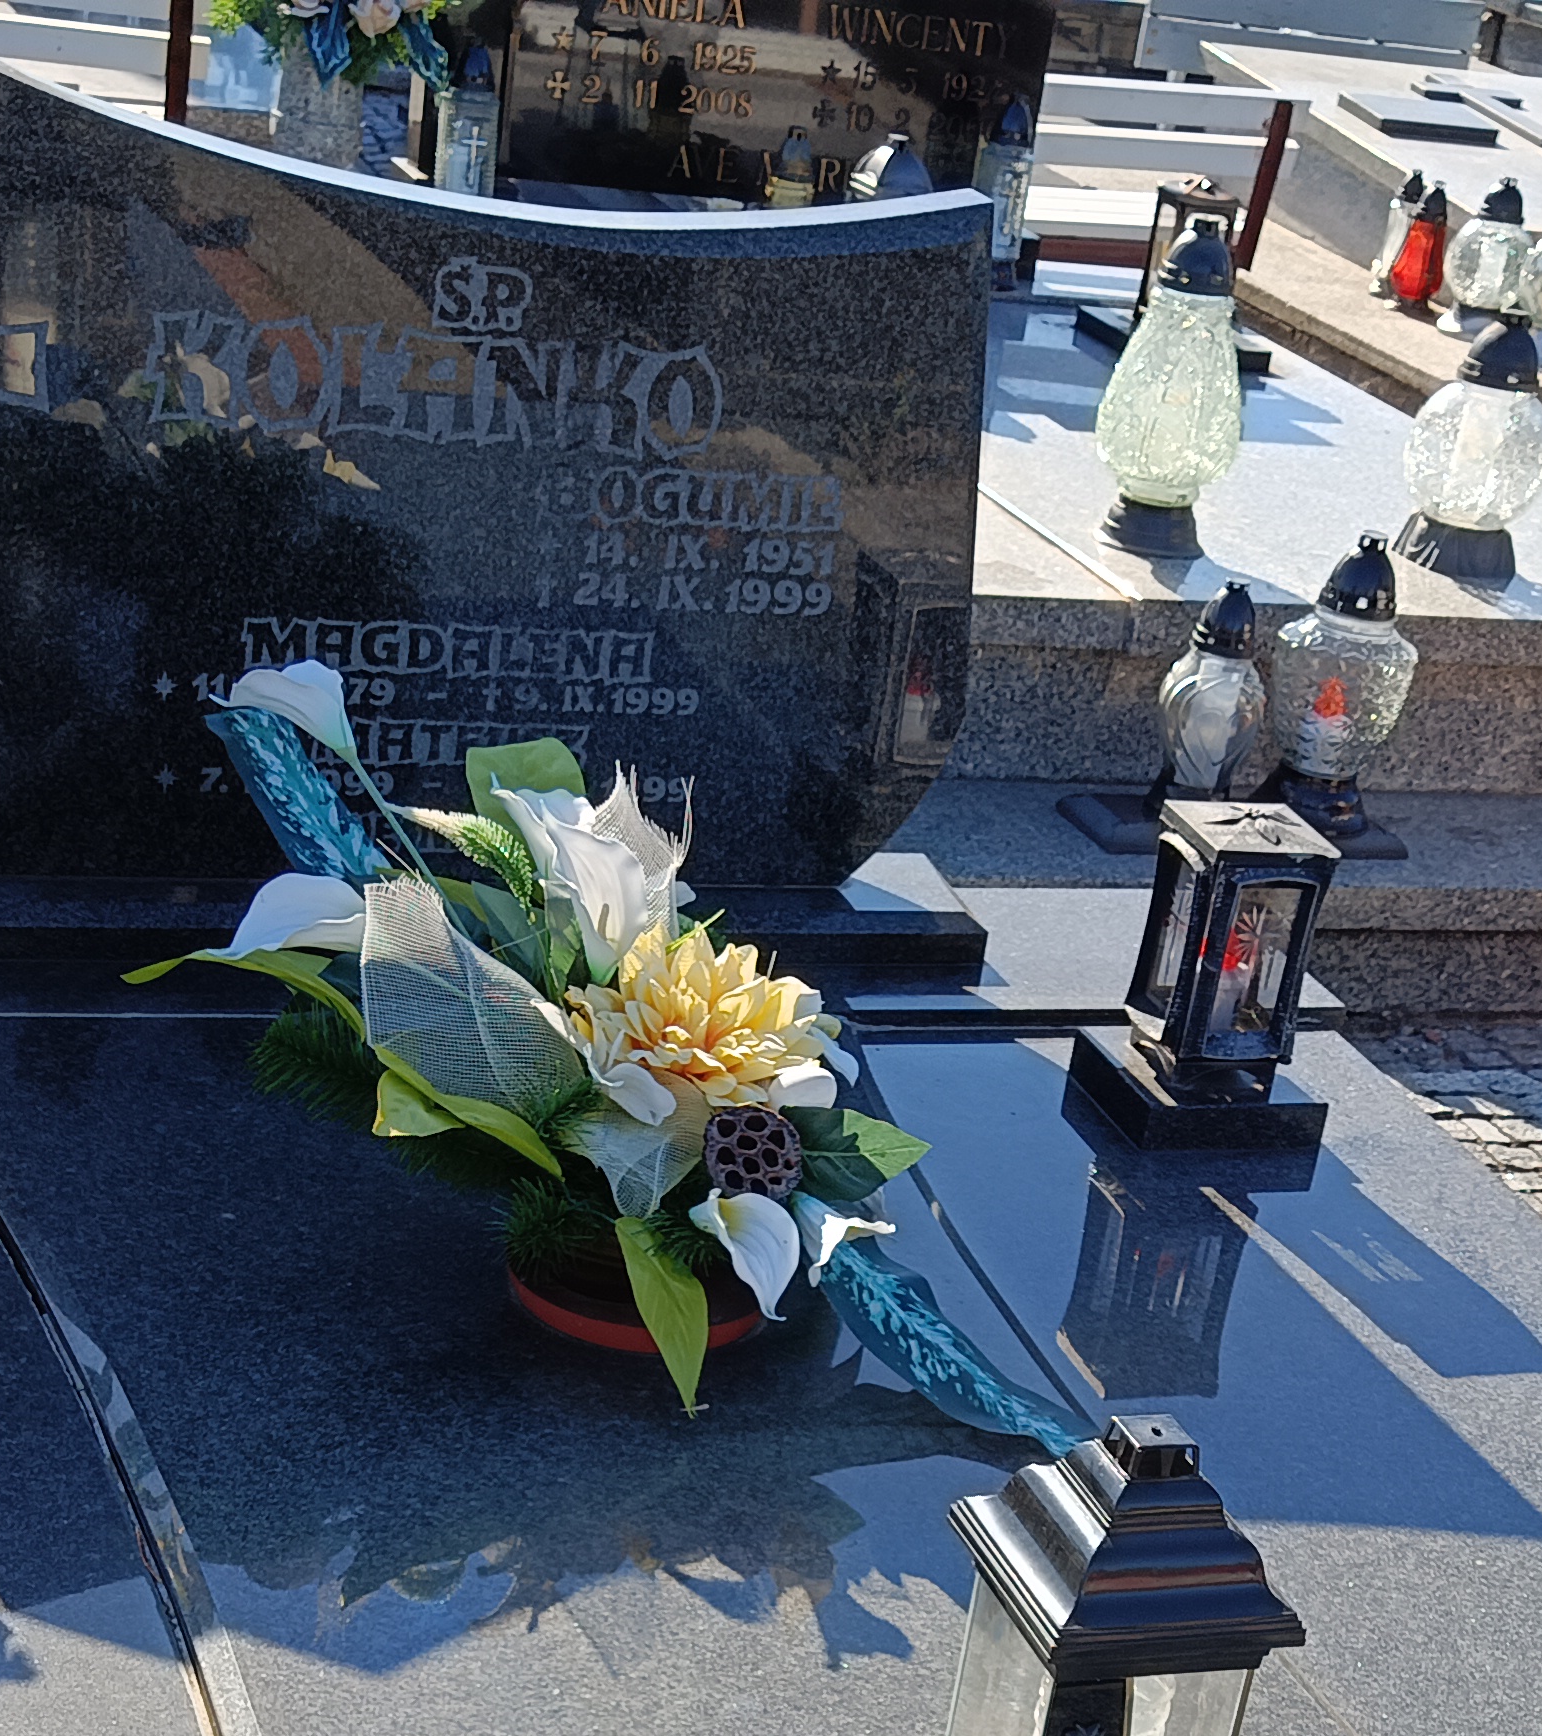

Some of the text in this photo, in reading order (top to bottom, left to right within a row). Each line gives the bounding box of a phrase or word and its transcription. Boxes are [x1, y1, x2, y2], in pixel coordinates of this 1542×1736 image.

[590, 30, 758, 75] 7 6 1925
[829, 3, 1016, 59] WINCENTY
[580, 74, 755, 119] 2 11 2008
[666, 144, 743, 185] AVE
[146, 308, 724, 461] KOLANKO
[240, 616, 657, 684] MAGDALENA
